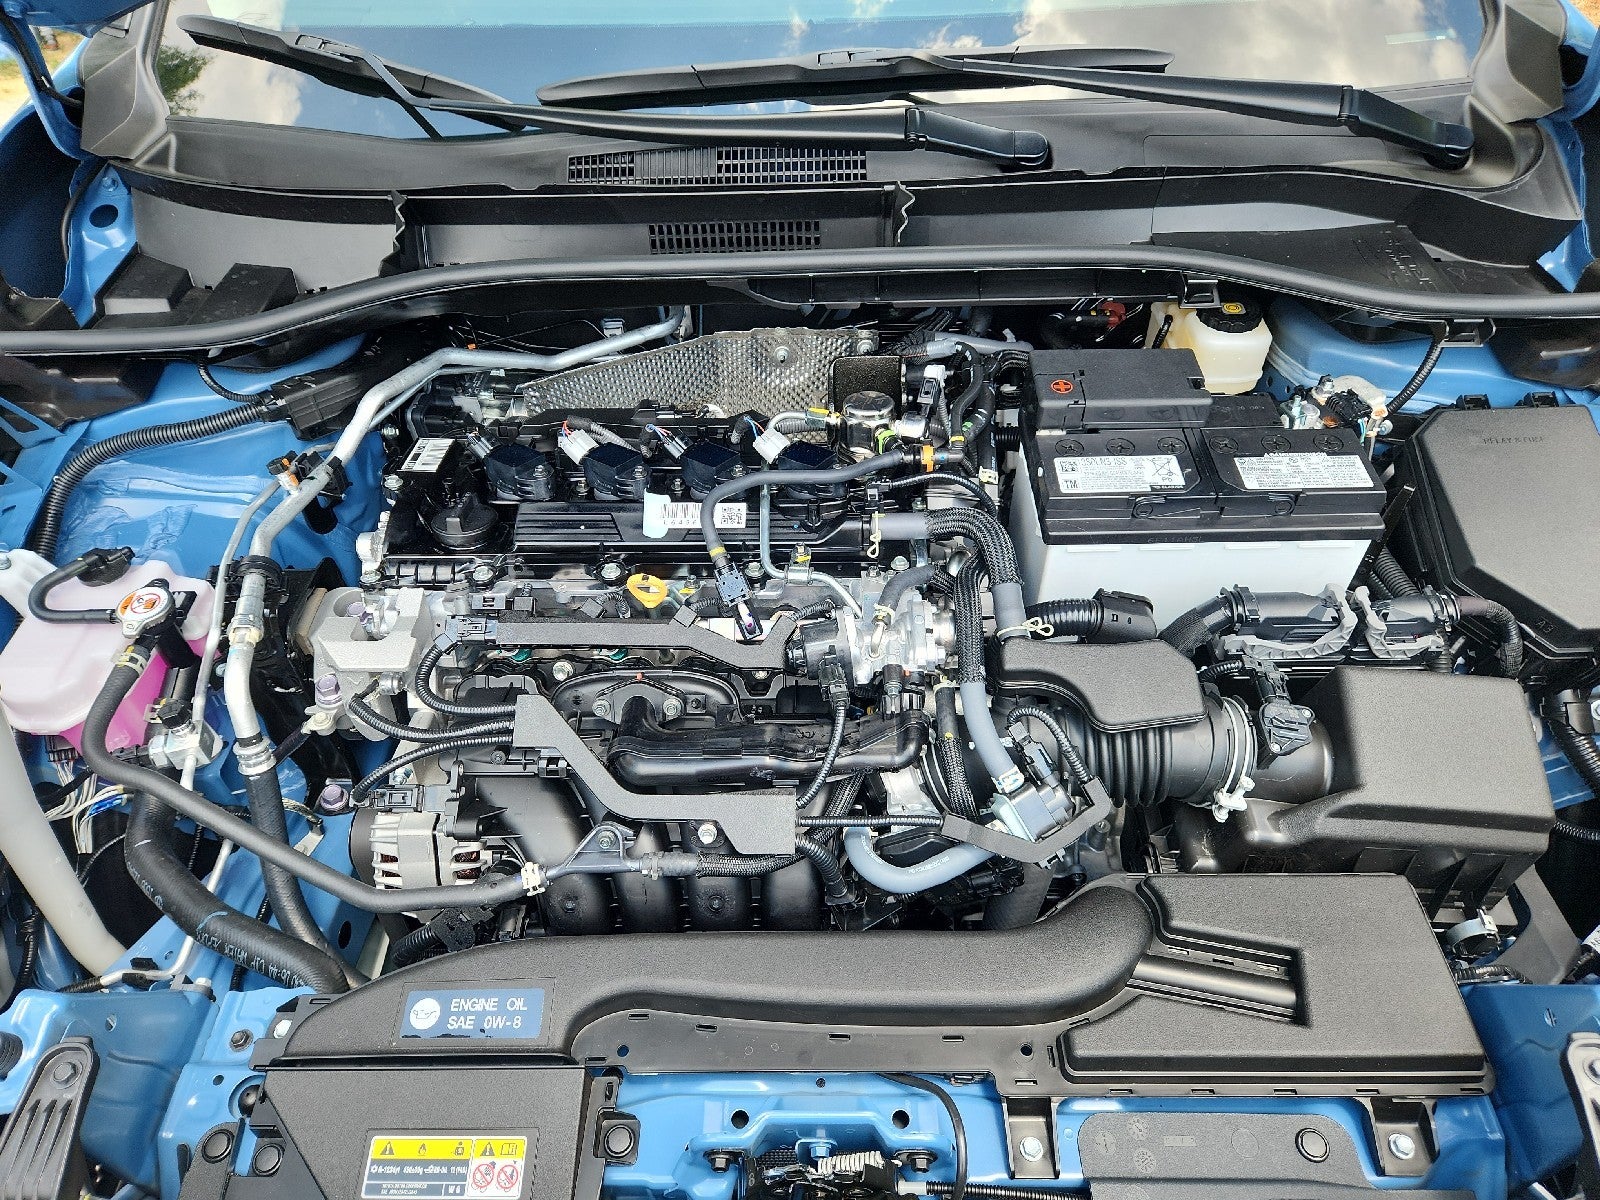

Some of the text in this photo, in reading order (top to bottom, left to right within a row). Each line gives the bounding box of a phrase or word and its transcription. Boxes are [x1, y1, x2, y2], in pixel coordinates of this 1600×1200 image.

[450, 997, 528, 1011] ENGINE OIL
[447, 1015, 522, 1029] SAE 0W-8
